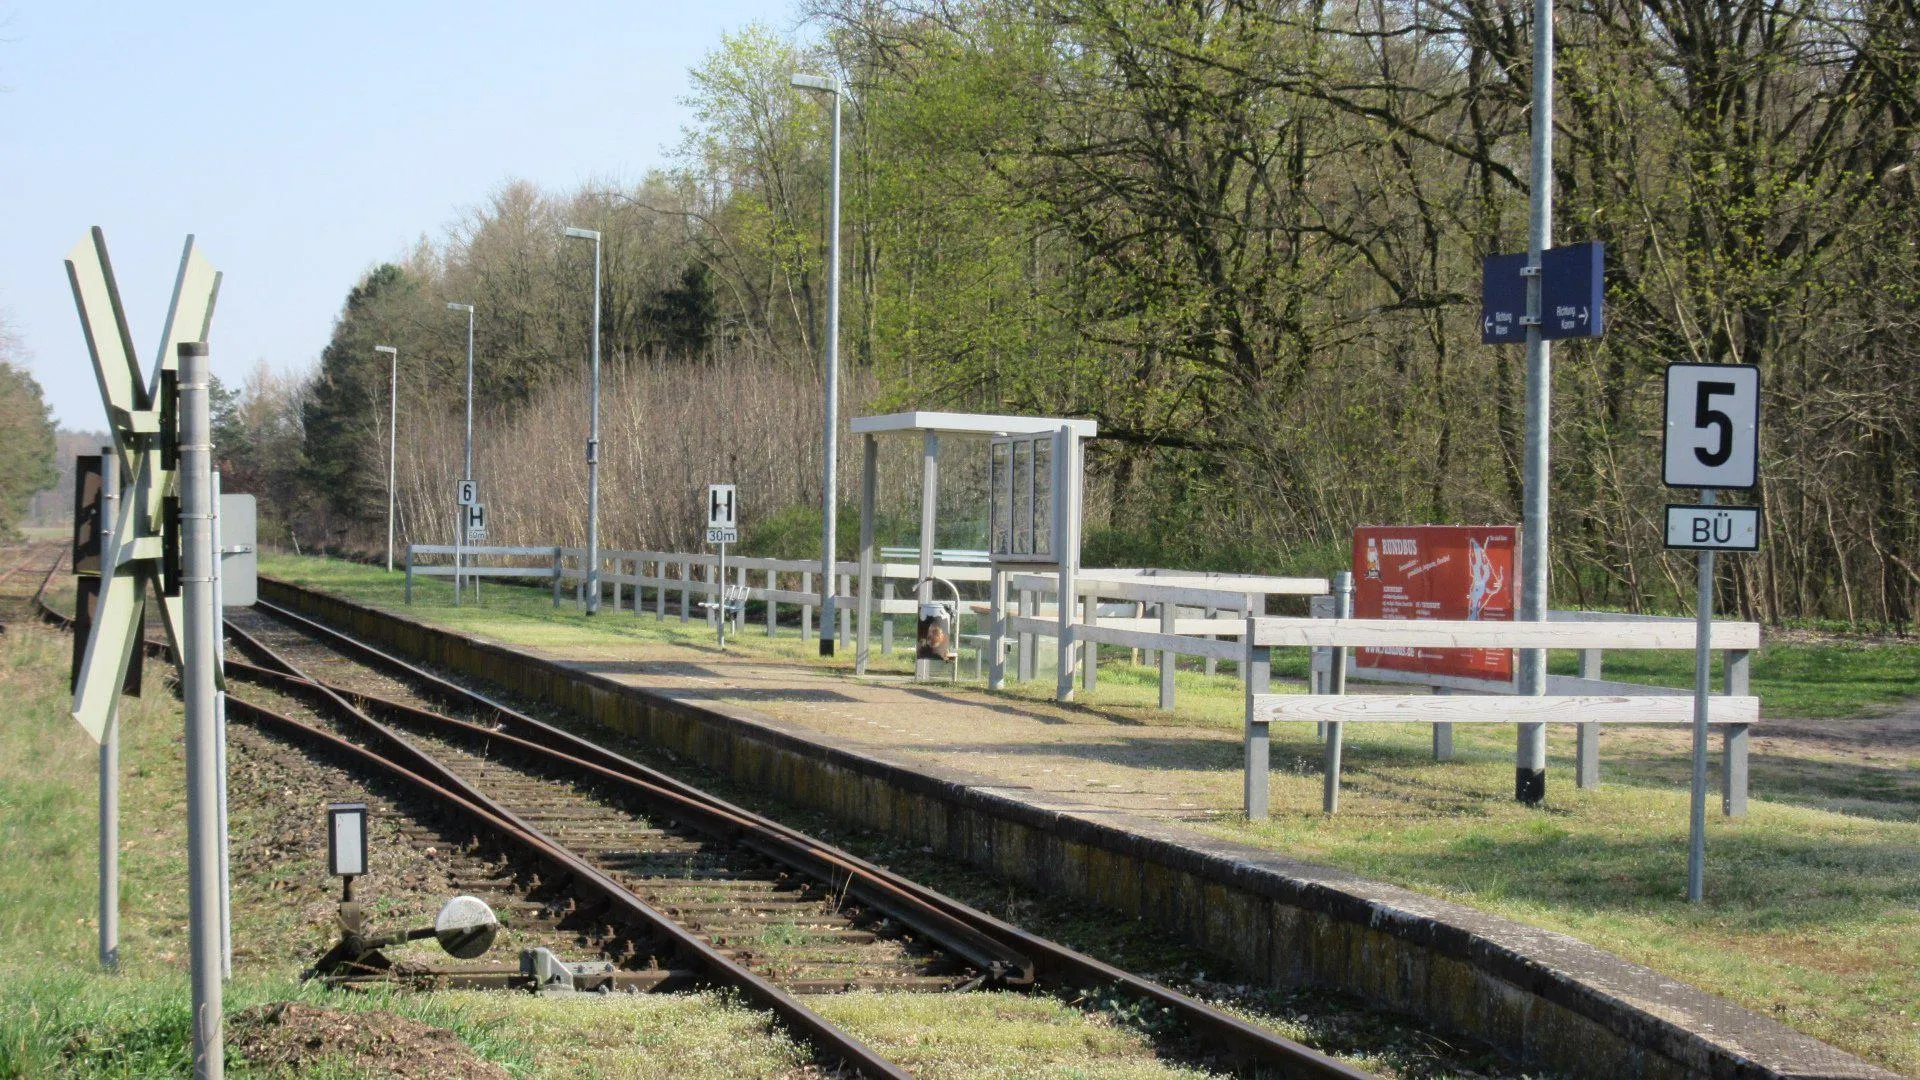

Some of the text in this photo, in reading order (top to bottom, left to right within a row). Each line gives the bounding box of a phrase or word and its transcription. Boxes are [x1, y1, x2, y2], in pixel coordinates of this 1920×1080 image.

[1556, 306, 1576, 317] Richtung
[1694, 381, 1735, 467] 5
[463, 484, 472, 501] 6
[711, 490, 732, 521] H
[470, 507, 483, 526] H
[709, 530, 735, 541] 30m
[1692, 512, 1732, 543] BÜ
[1381, 538, 1418, 556] RUNDBUS
